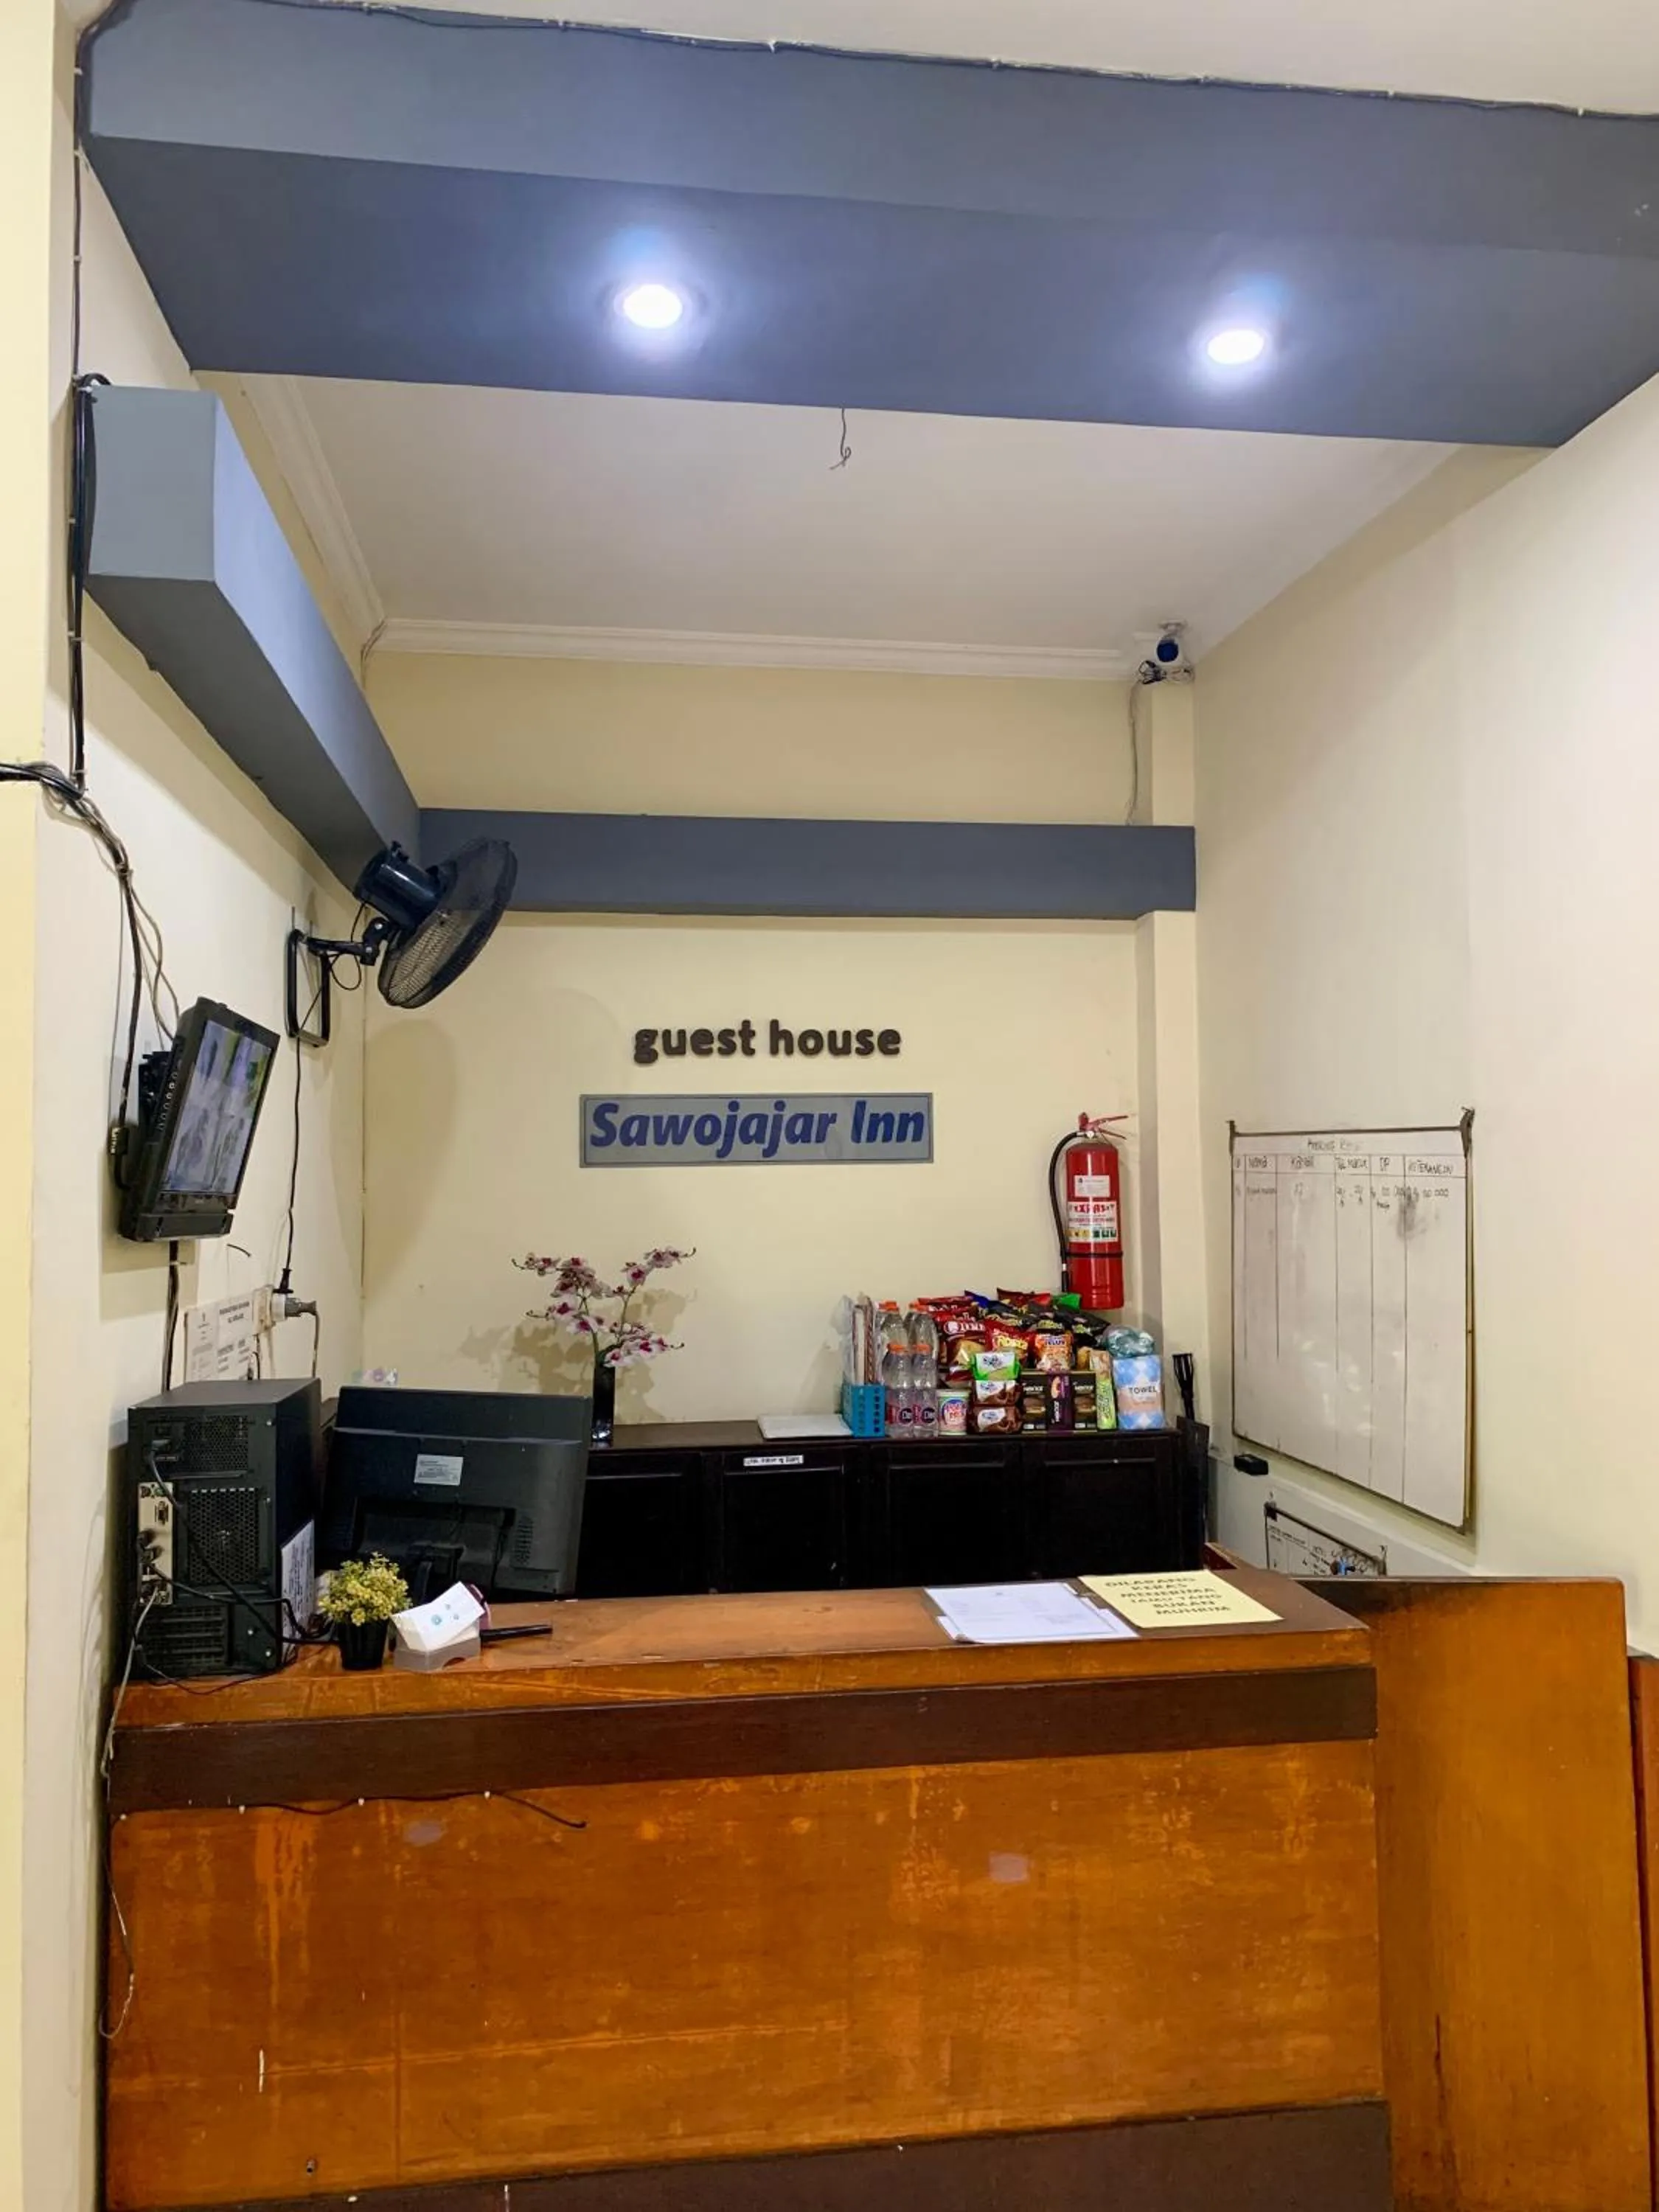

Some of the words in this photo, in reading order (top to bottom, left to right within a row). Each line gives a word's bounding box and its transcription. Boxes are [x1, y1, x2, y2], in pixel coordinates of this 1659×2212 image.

[633, 1019, 756, 1064] guest
[769, 1019, 902, 1057] house
[591, 1100, 837, 1158] Sawojajar
[850, 1100, 925, 1144] Inn
[1128, 1386, 1158, 1395] TOWEL
